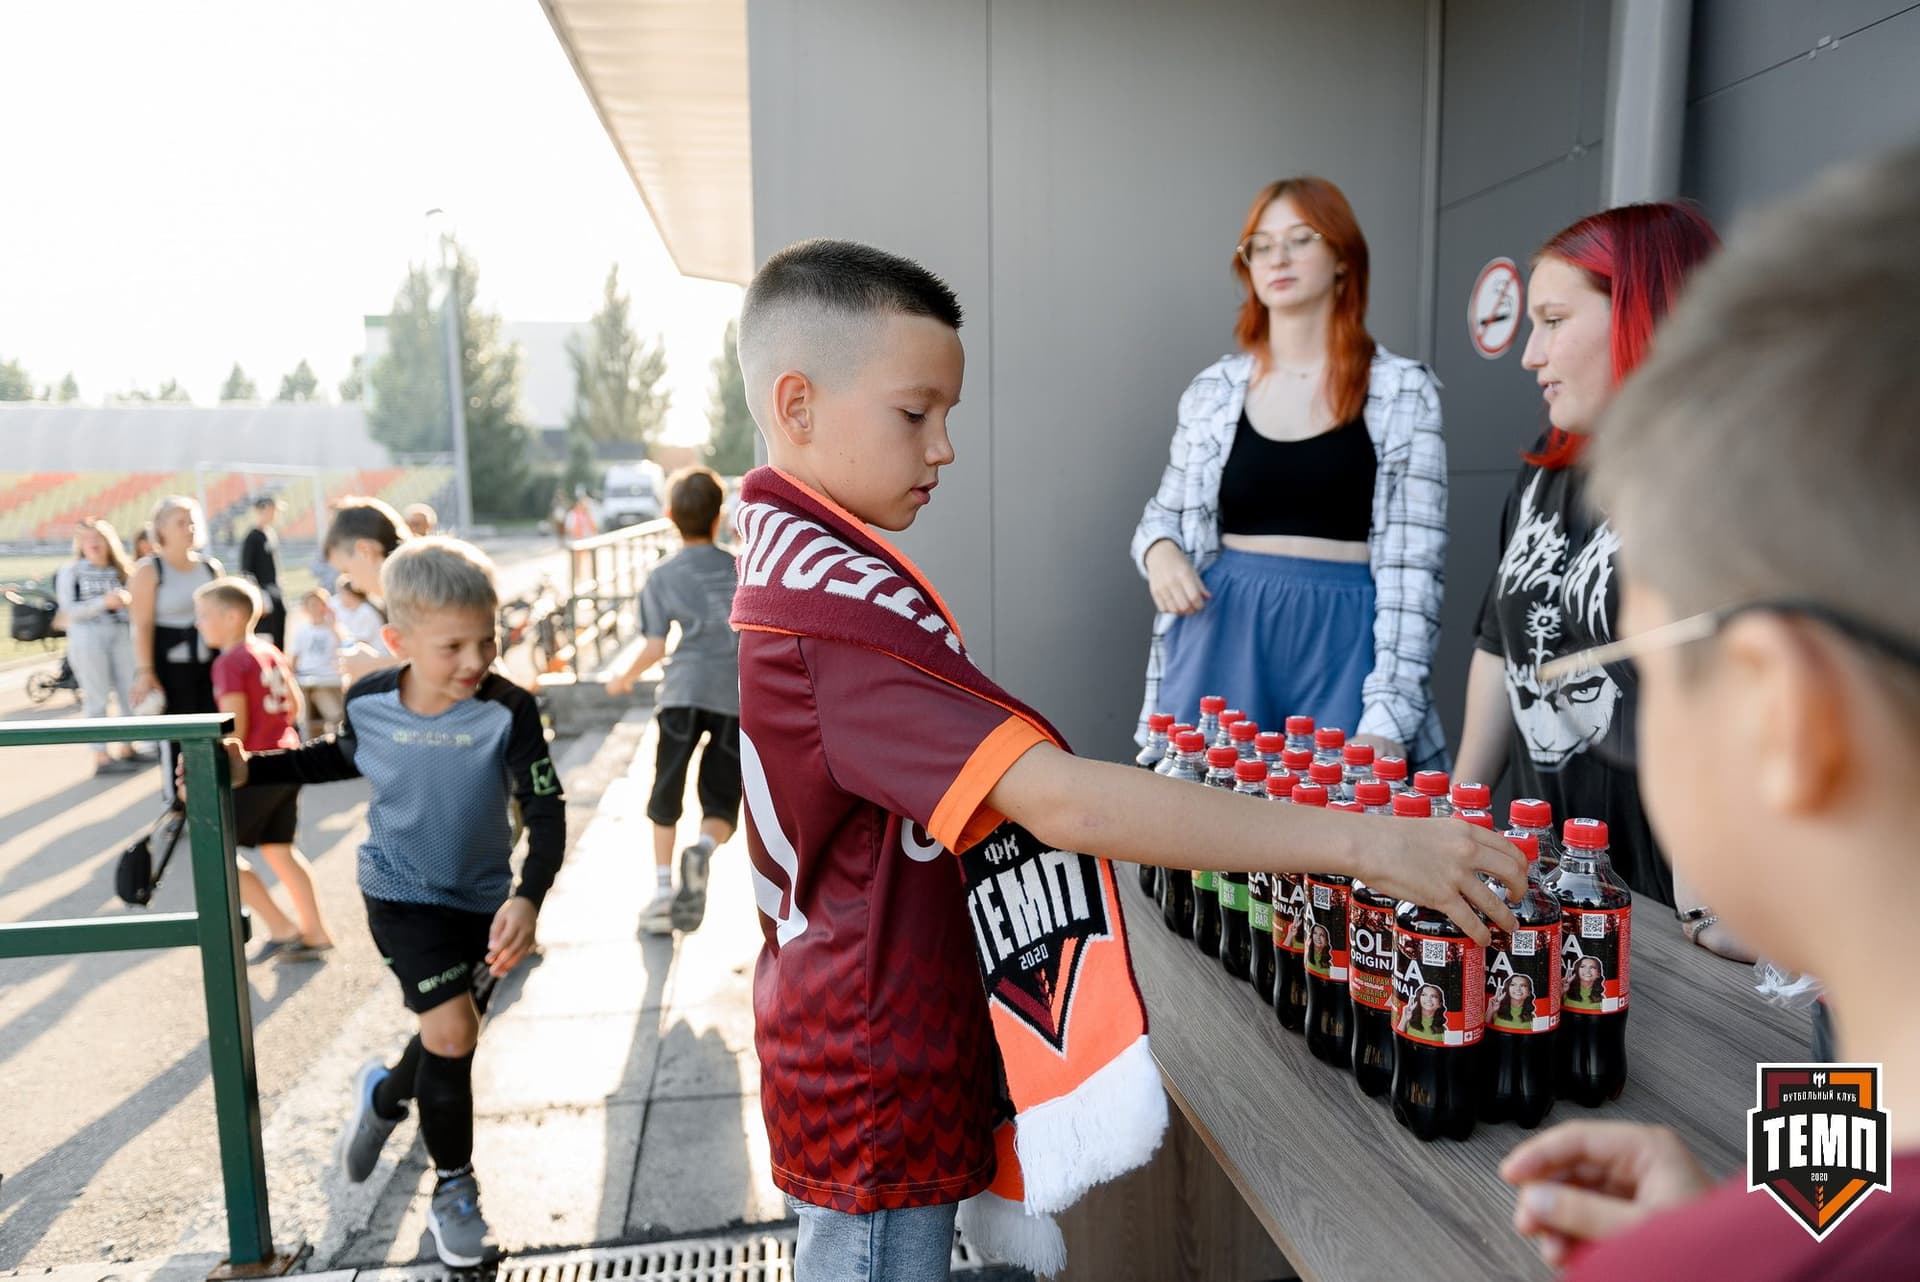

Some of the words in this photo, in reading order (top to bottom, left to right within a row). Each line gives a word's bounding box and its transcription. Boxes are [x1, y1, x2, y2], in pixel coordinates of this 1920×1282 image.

[984, 834, 1019, 864] ФК
[1349, 922, 1393, 957] COL
[1018, 944, 1049, 970] 2020
